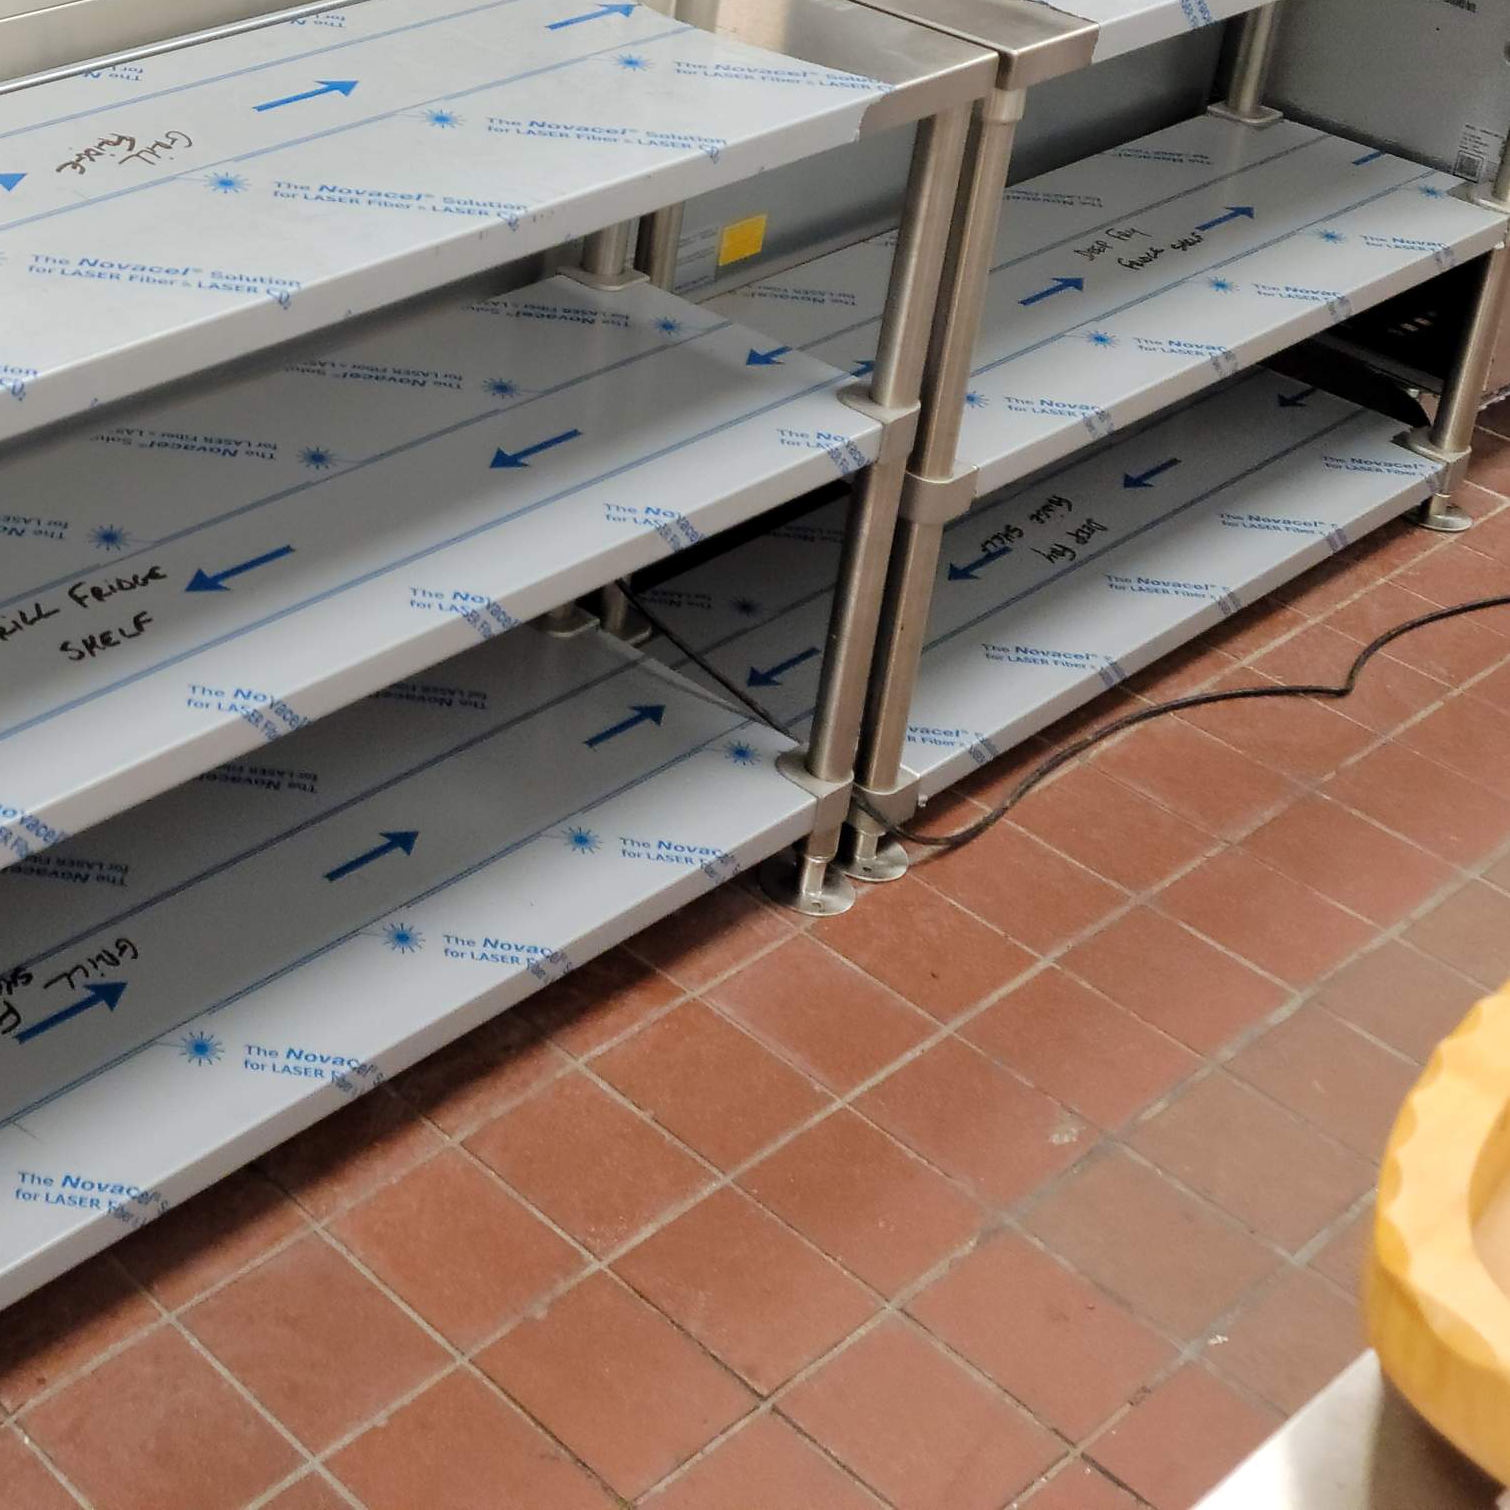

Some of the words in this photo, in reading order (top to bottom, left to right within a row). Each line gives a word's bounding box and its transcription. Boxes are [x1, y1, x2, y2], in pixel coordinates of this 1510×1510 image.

[274, 180, 311, 192] The
[304, 192, 361, 206] LASER
[27, 264, 54, 274] for
[60, 268, 121, 281] LASER
[197, 281, 258, 294] LASER
[31, 254, 70, 265] The
[210, 271, 302, 289] Solution
[243, 1044, 279, 1060] The
[18, 1171, 55, 1189] The
[44, 1193, 101, 1210] LASER
